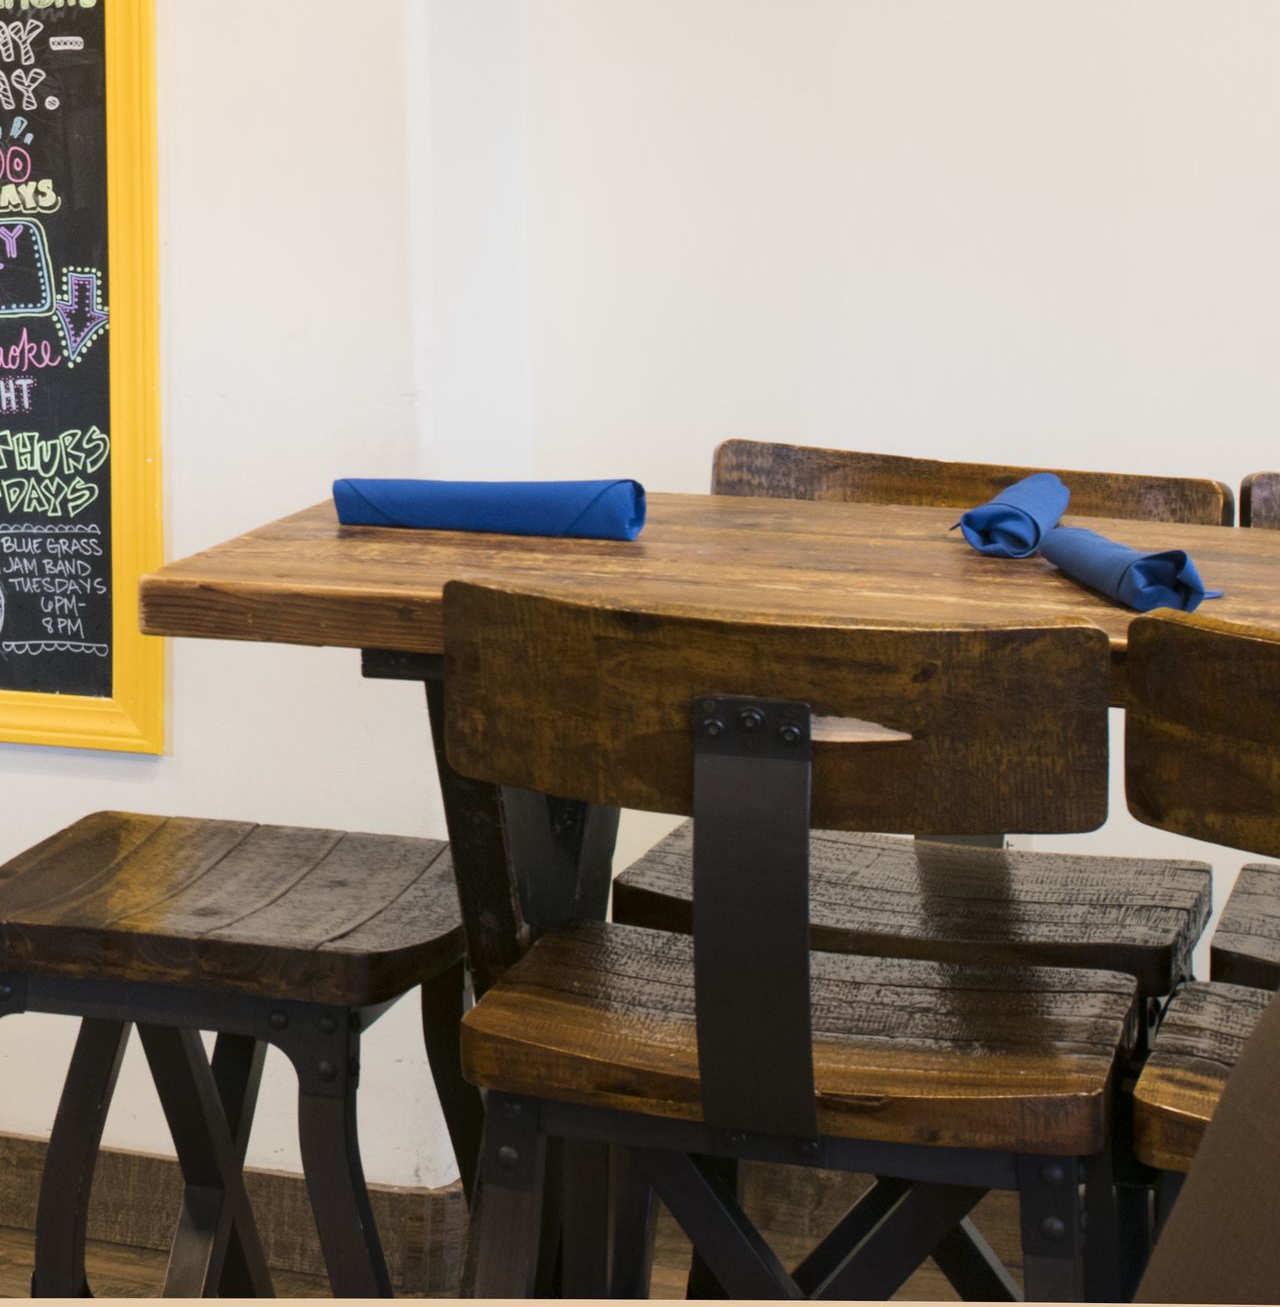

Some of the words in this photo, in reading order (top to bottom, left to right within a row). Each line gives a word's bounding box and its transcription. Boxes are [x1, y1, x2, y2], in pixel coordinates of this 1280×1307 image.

[0, 537, 42, 554] BLUE
[46, 539, 103, 556] GRASS
[2, 559, 38, 576] JAM
[43, 559, 92, 576] BAND
[8, 577, 107, 594] TUESDAYS
